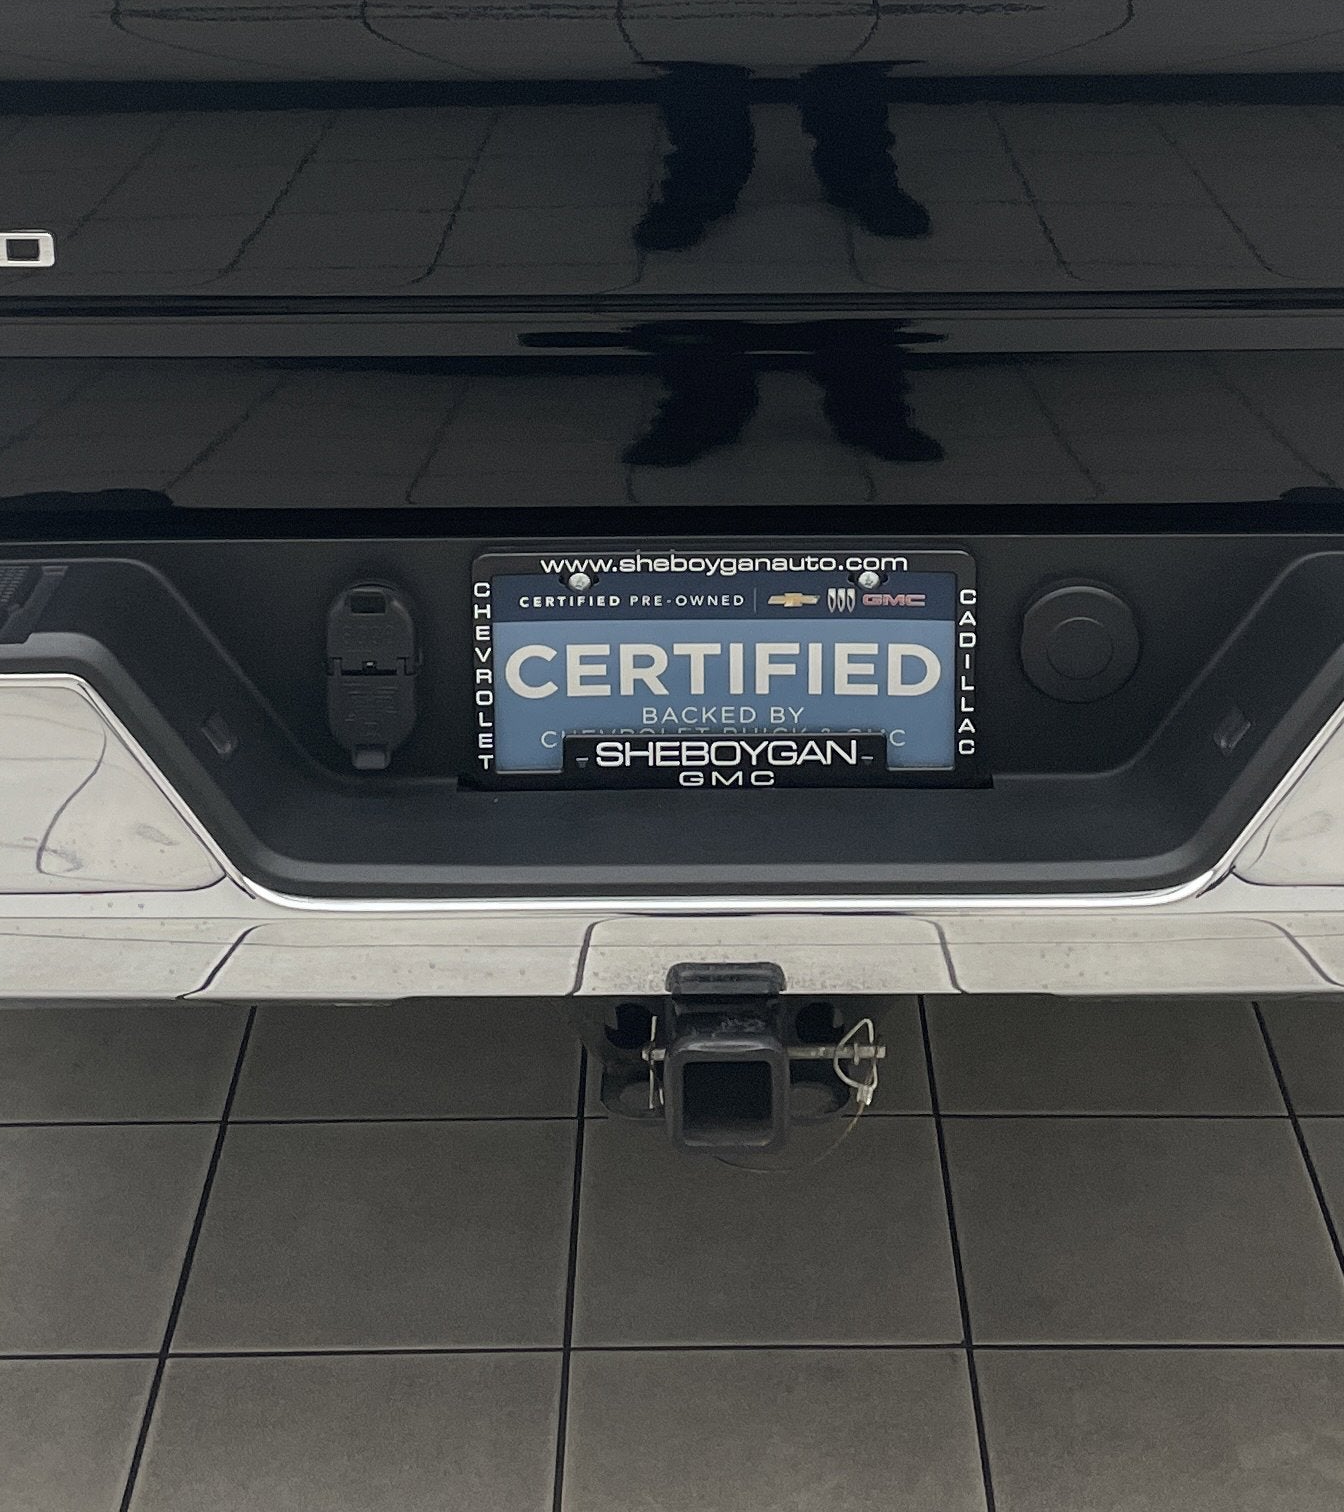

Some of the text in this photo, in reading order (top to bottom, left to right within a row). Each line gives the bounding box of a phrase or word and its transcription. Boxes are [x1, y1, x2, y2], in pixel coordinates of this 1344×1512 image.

[540, 554, 909, 577] www.sheboyganauto.com
[519, 594, 745, 608] CERTIFIED PRE-OWNED
[862, 593, 926, 607] GMC
[473, 582, 494, 770] CHEVROLET
[505, 642, 942, 699] CERTIFIED
[958, 589, 977, 756] CADILLAC
[642, 706, 805, 725] BACKED BY
[595, 739, 858, 768] SHEBOYGAN
[678, 771, 776, 787] GMC
